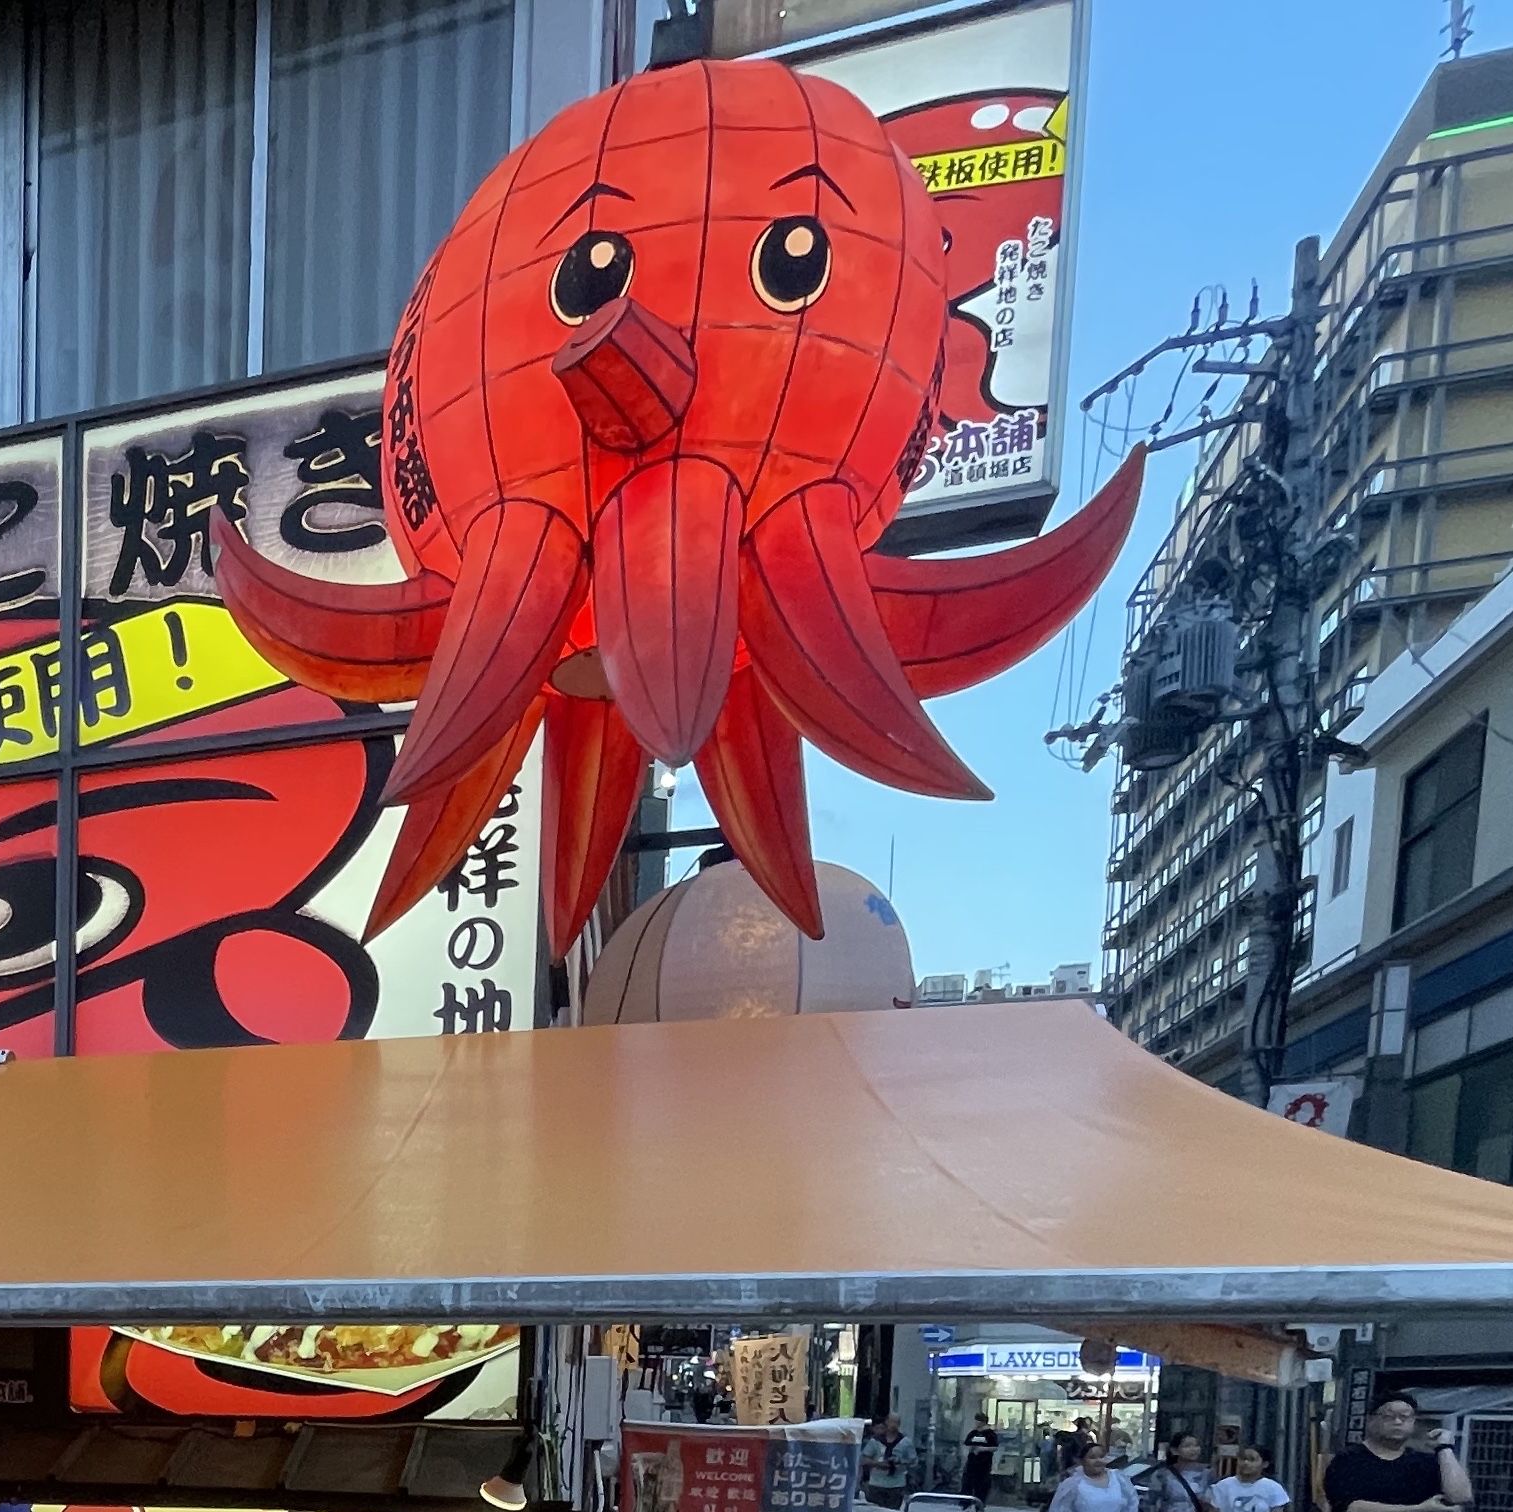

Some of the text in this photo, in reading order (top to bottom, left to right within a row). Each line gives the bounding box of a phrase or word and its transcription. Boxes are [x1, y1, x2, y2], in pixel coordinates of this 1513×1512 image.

[1026, 217, 1052, 302] たこ焼き
[435, 785, 519, 1036] 祥の地
[695, 1471, 755, 1483] WELCOME
[773, 1470, 847, 1490] ドリンク
[770, 1490, 845, 1508] あります
